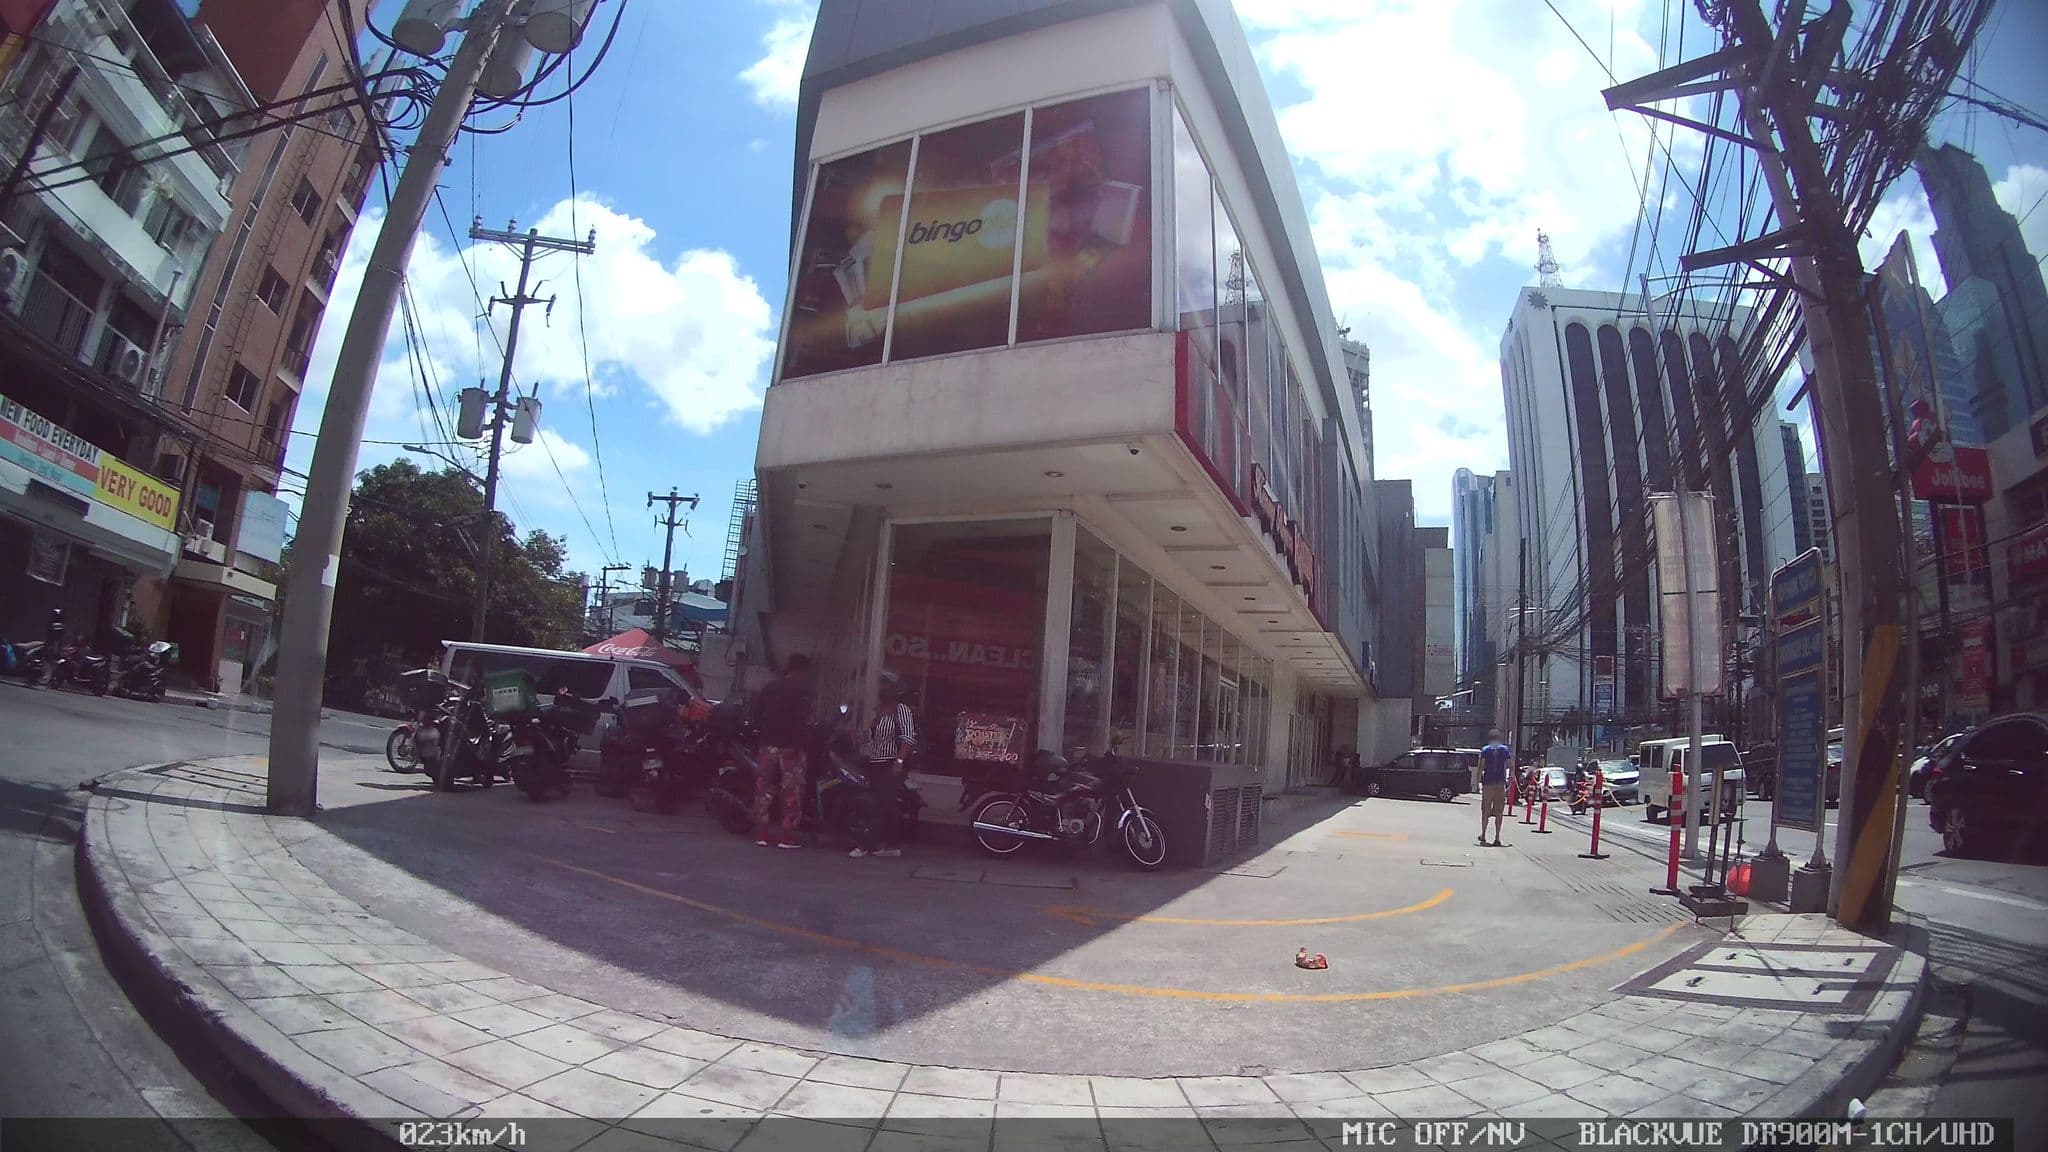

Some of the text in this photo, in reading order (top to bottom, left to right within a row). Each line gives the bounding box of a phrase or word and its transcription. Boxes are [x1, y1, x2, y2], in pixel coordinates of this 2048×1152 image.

[908, 219, 983, 244] bingo
[24, 410, 51, 439] FOOD
[51, 425, 99, 463] EVERYDAY
[1931, 468, 1985, 489] Jolbee
[101, 466, 137, 502] VERY
[139, 485, 172, 518] GOOD
[2023, 537, 2048, 562] MA
